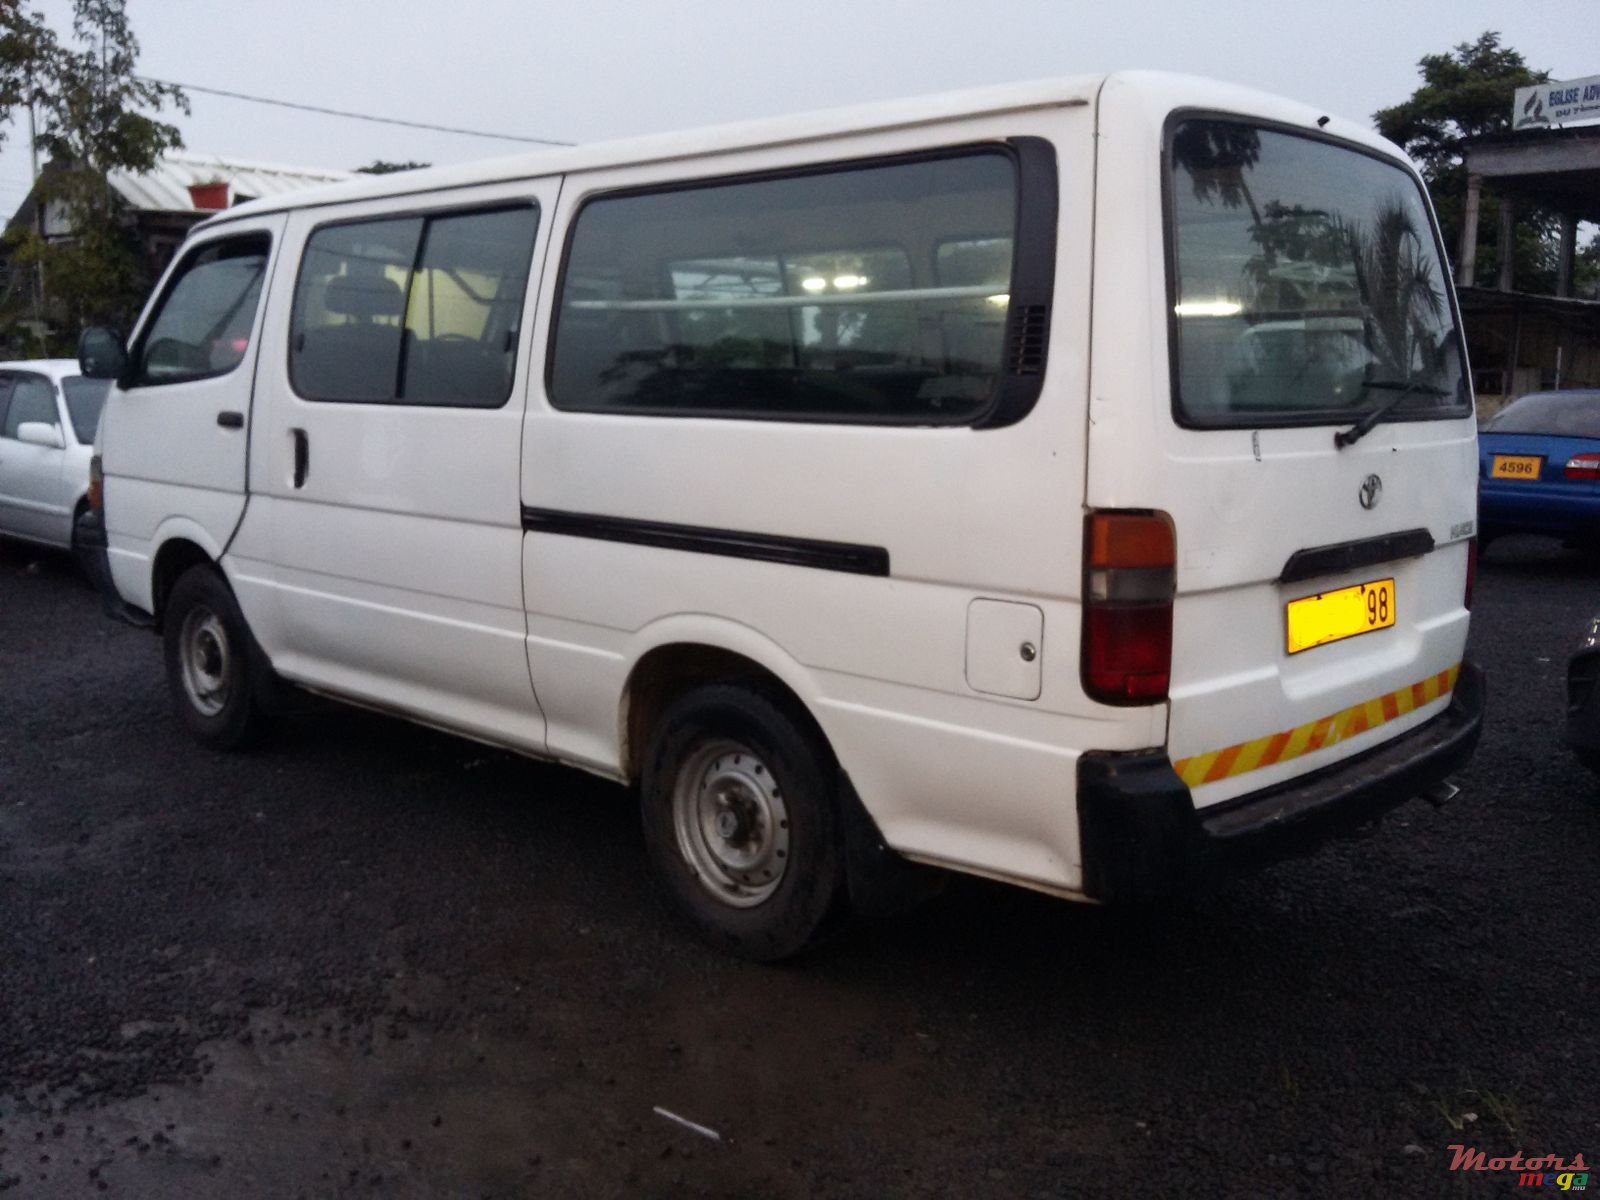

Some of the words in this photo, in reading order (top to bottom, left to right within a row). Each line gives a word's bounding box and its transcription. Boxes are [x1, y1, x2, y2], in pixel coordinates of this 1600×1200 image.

[1549, 87, 1580, 107] EGLISE
[1499, 461, 1533, 474] 4596
[1367, 586, 1388, 625] 98
